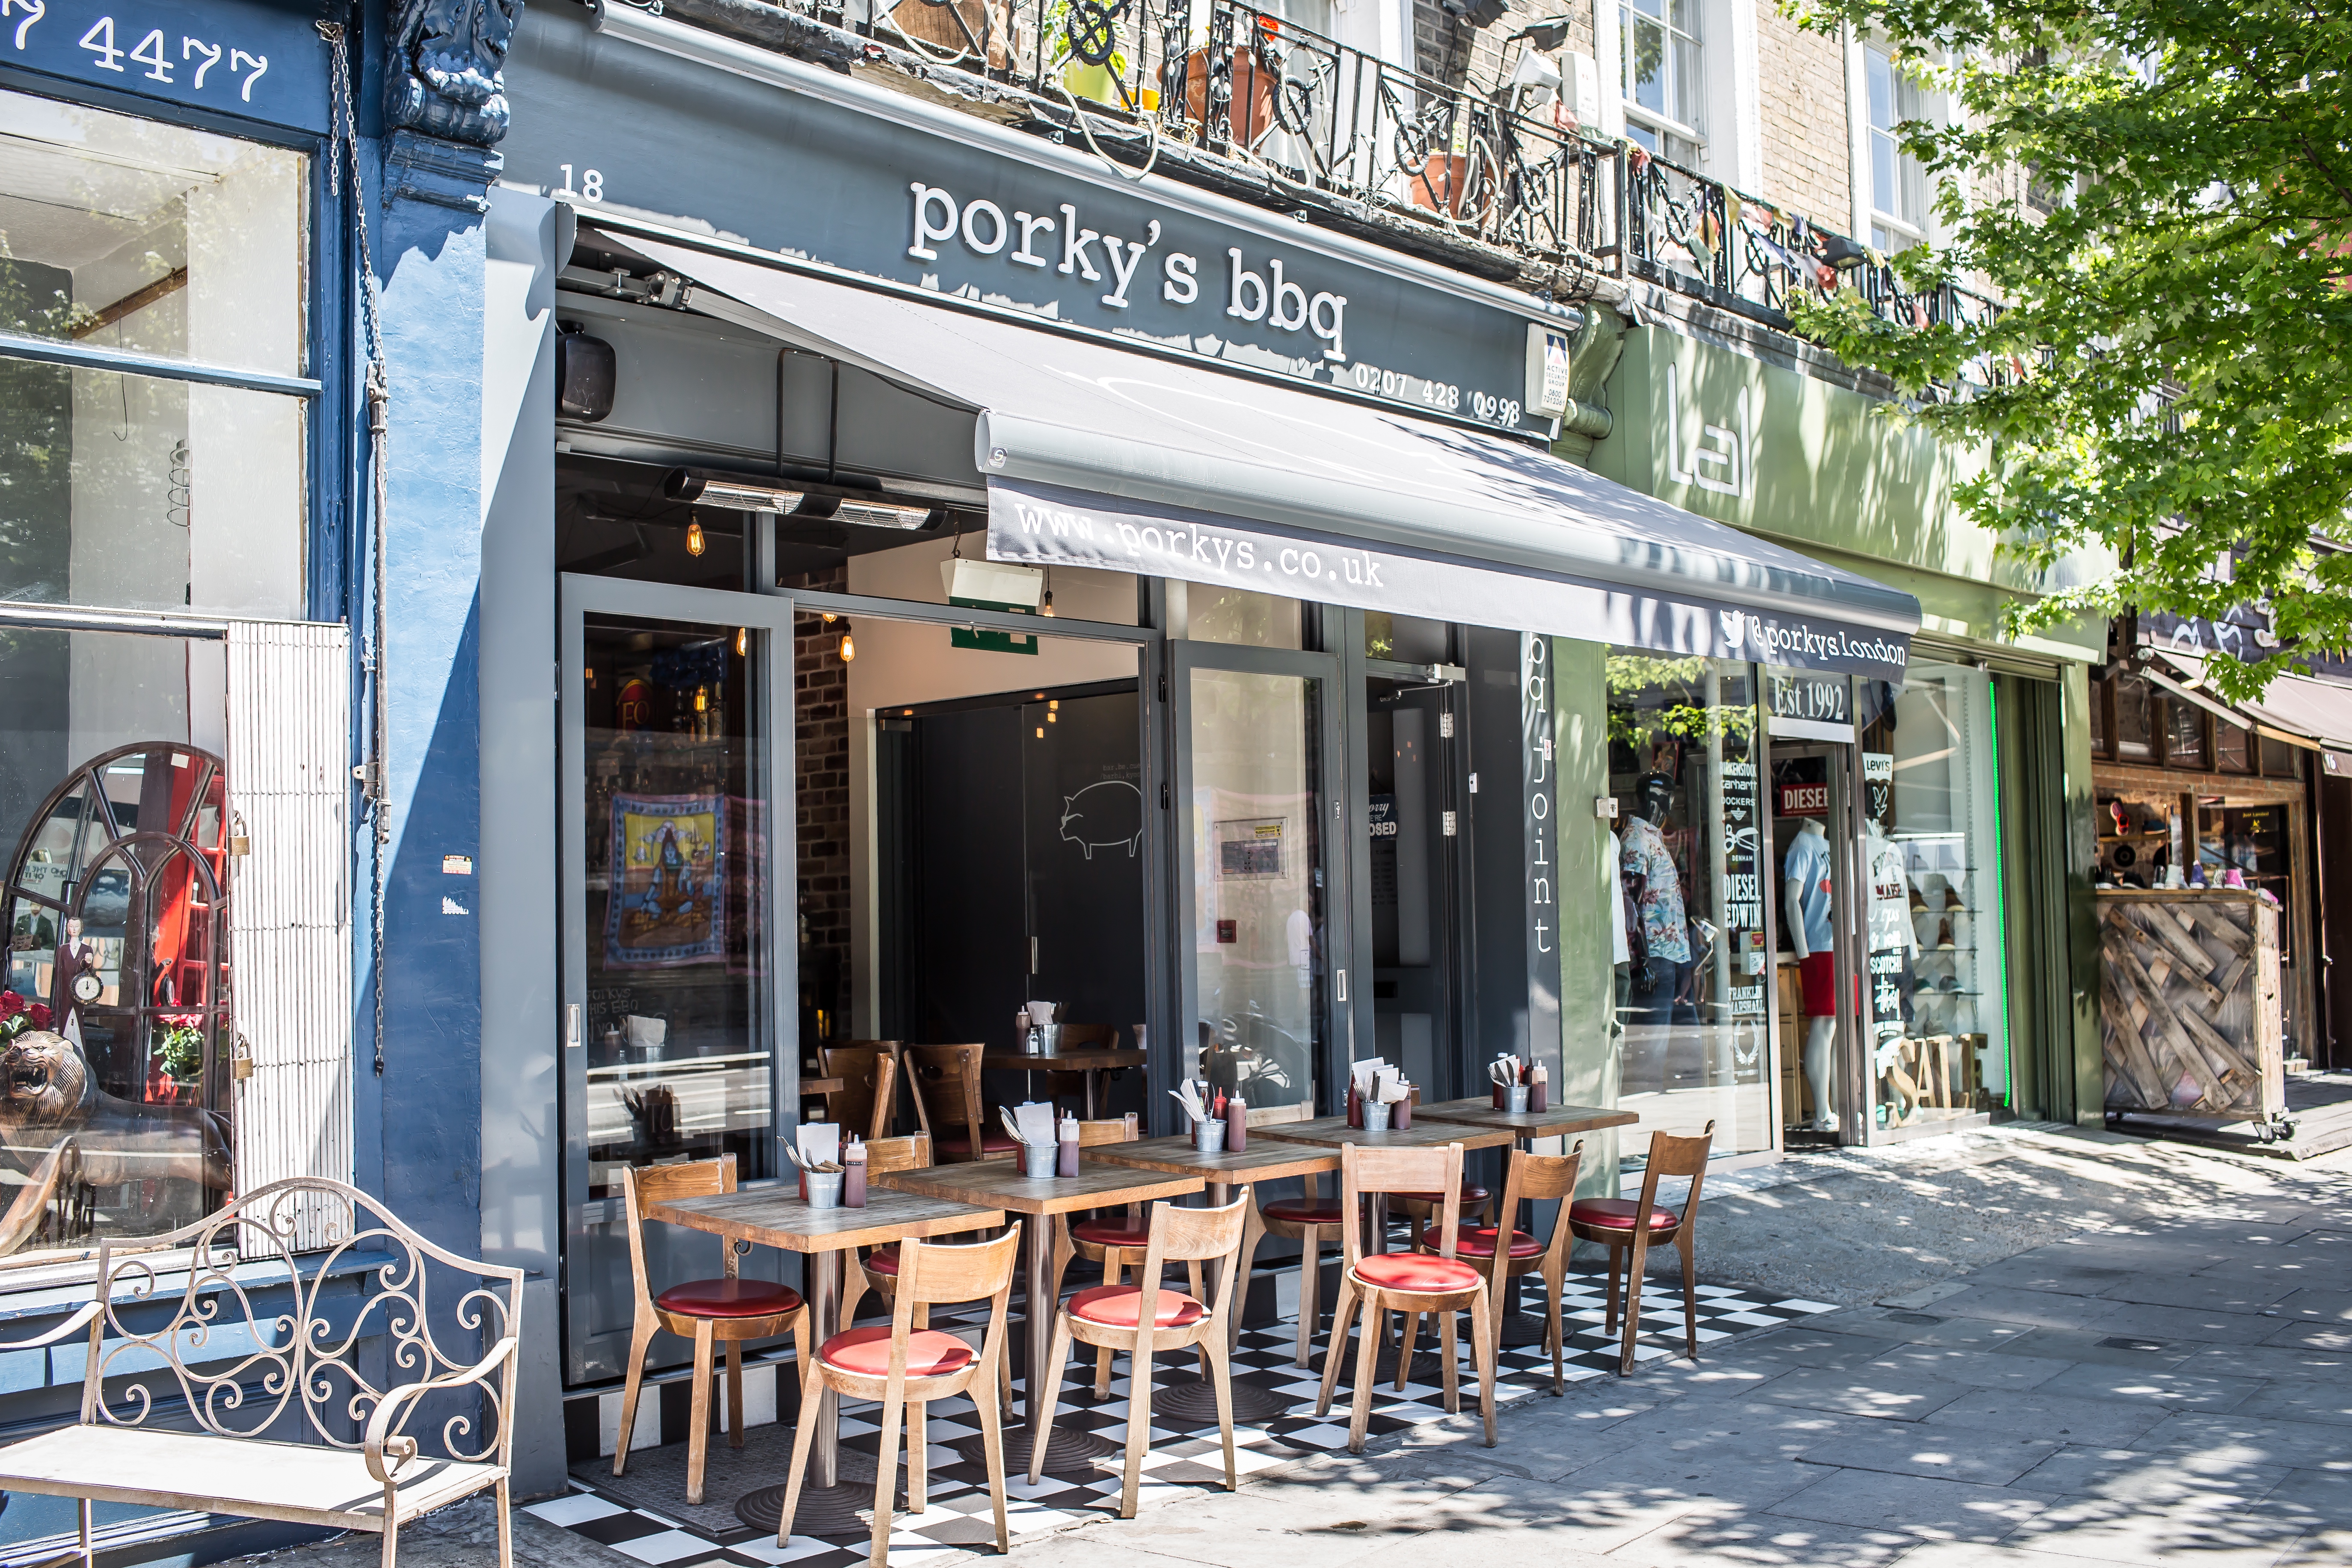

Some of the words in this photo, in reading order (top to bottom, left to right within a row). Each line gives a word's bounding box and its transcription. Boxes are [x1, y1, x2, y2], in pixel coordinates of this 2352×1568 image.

[79, 17, 268, 102] 4477
[558, 163, 604, 203] 18
[908, 181, 1199, 308] porky's
[1226, 247, 1348, 362] bbq
[1546, 372, 1567, 381] SECURITY
[1547, 365, 1568, 375] ACTIVE
[1548, 379, 1565, 387] GROUP
[1355, 363, 1408, 398] 0207
[1422, 379, 1459, 409] 428
[1473, 391, 1520, 424] 0998
[1014, 502, 1384, 588] www.porkys.co.uk
[1752, 615, 1906, 667] @porkyslondon
[1720, 779, 1757, 791] carhartt
[1720, 796, 1756, 806] DOCKERS
[1369, 803, 1389, 817] orry
[1370, 821, 1397, 836] OSED
[1723, 874, 1761, 901] DIESEL
[1723, 904, 1762, 928] EDWIN
[1727, 985, 1763, 1002] FRANKLIN
[1727, 999, 1765, 1015] MARSHALL
